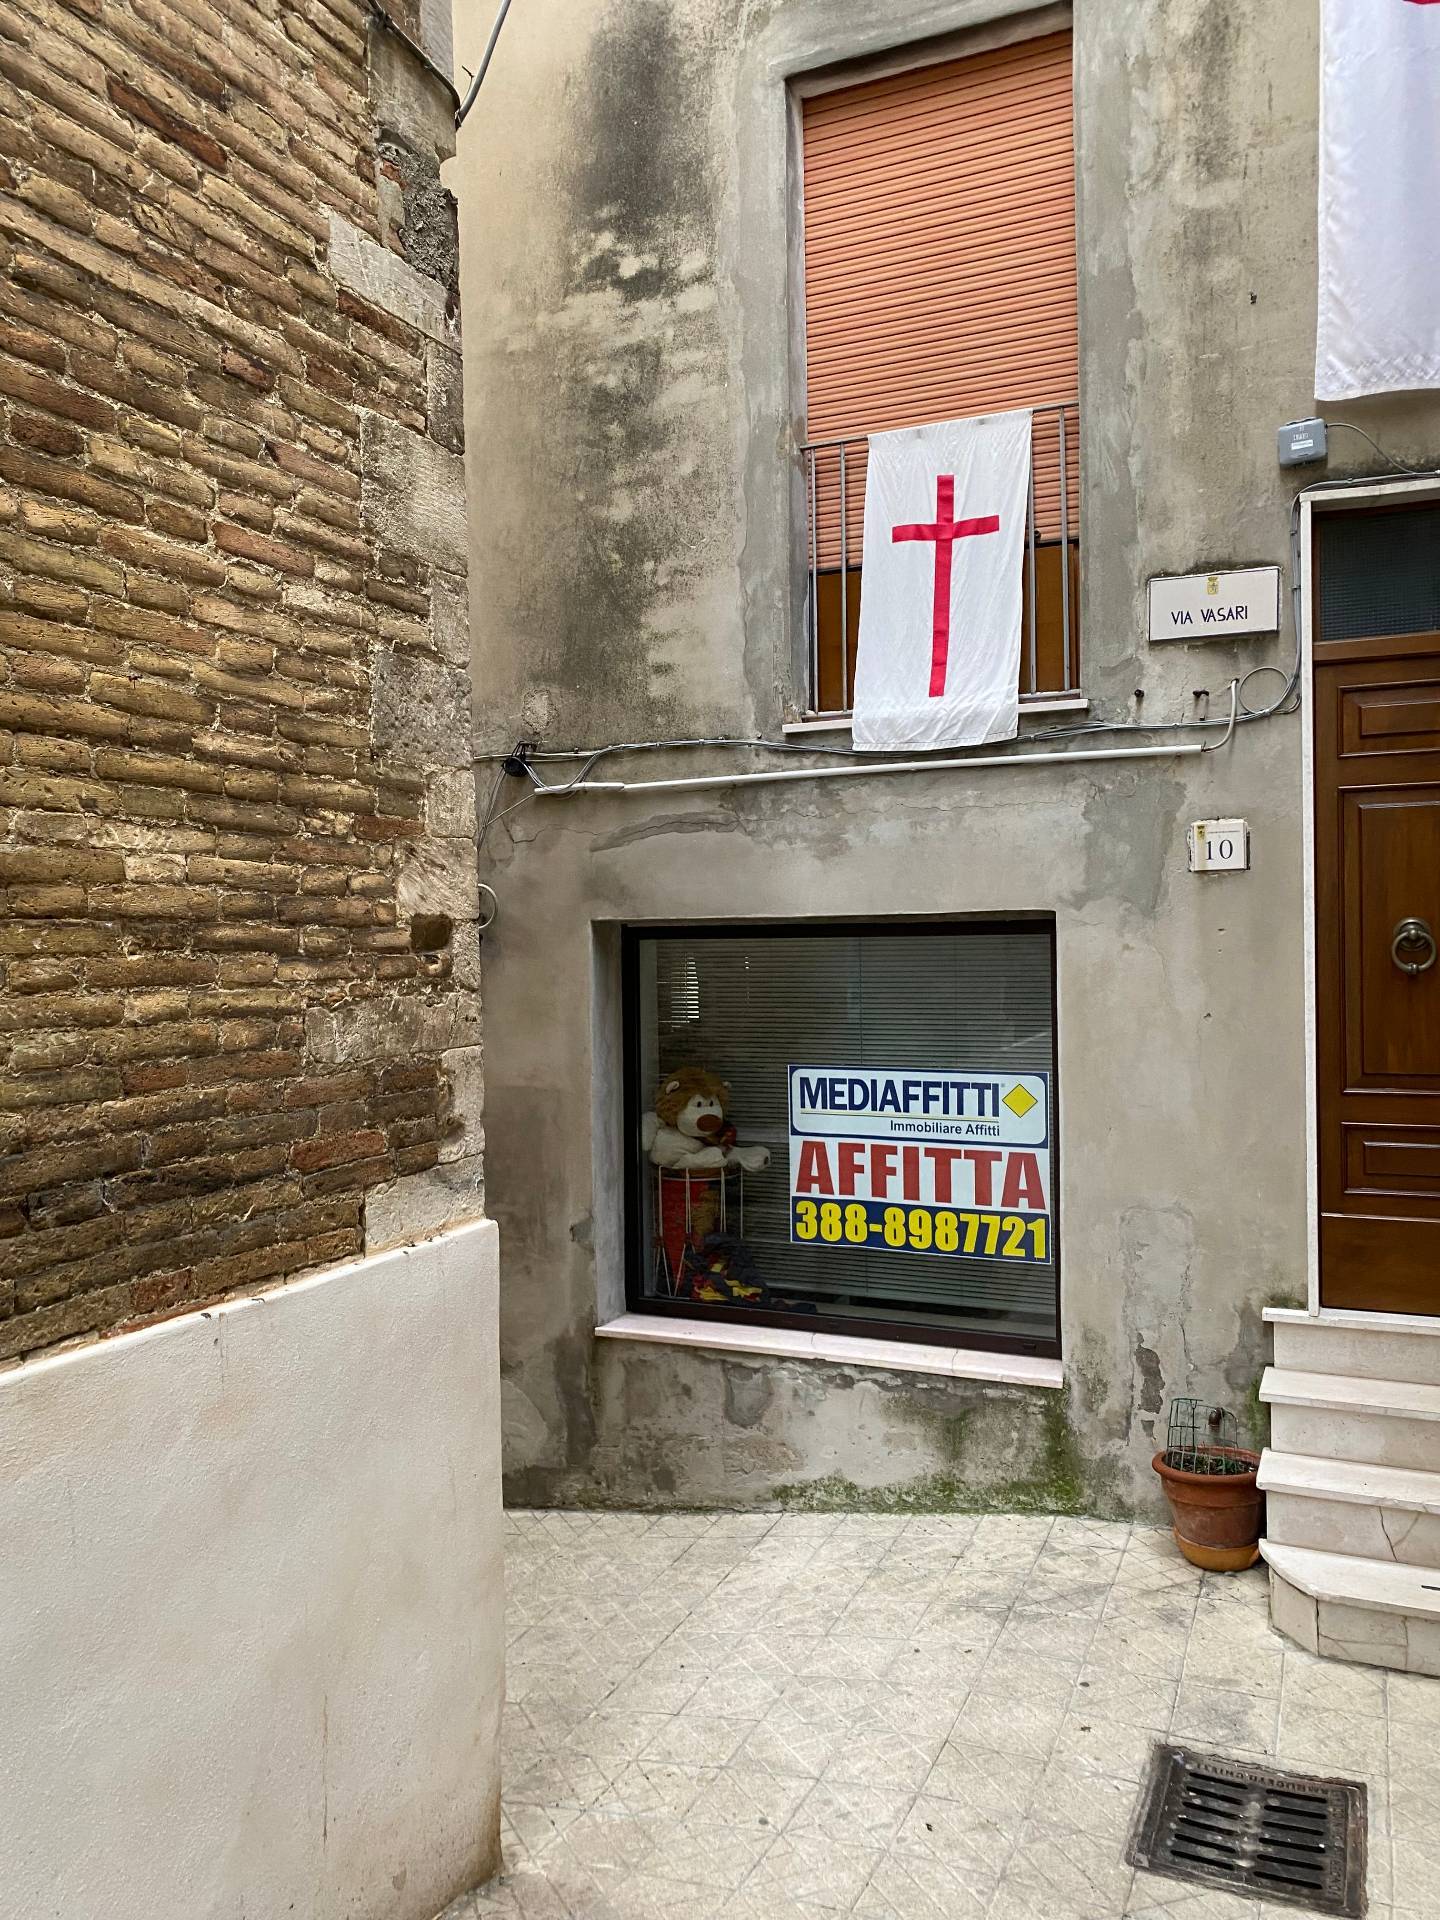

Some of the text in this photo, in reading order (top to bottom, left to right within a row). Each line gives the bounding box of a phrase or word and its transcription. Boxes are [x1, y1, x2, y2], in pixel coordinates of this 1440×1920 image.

[1170, 605, 1248, 625] VIA VASARI
[1205, 839, 1234, 861] 10
[799, 1076, 1000, 1118] MEDIAFFITTI
[890, 1119, 1000, 1137] Immobiliare Affitti
[795, 1140, 1047, 1211] AFFITTA
[795, 1200, 1047, 1260] 388-8987721
